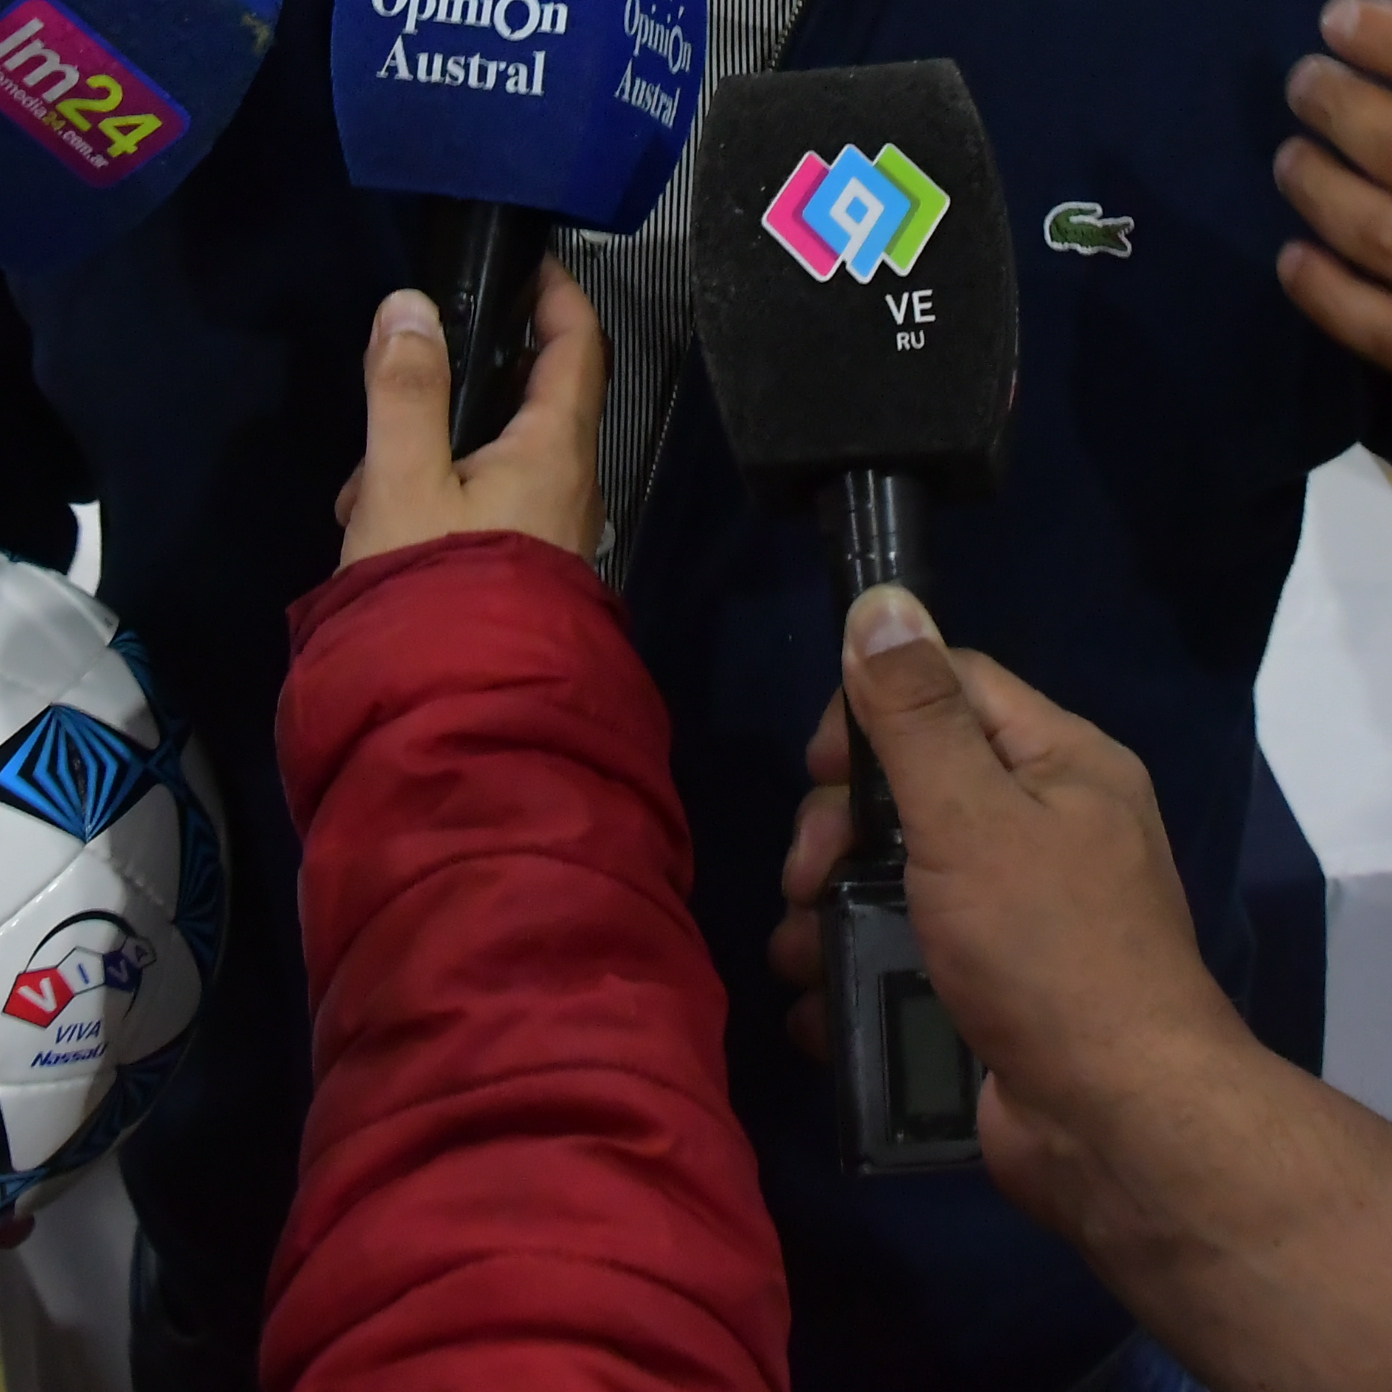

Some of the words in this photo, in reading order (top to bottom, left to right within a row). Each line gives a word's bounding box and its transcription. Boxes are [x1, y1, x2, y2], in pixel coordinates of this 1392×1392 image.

[376, 34, 546, 97] Austral
[614, 58, 681, 129] Austral
[885, 289, 936, 326] VE
[896, 330, 926, 352] RU
[55, 1020, 102, 1044] VIVA
